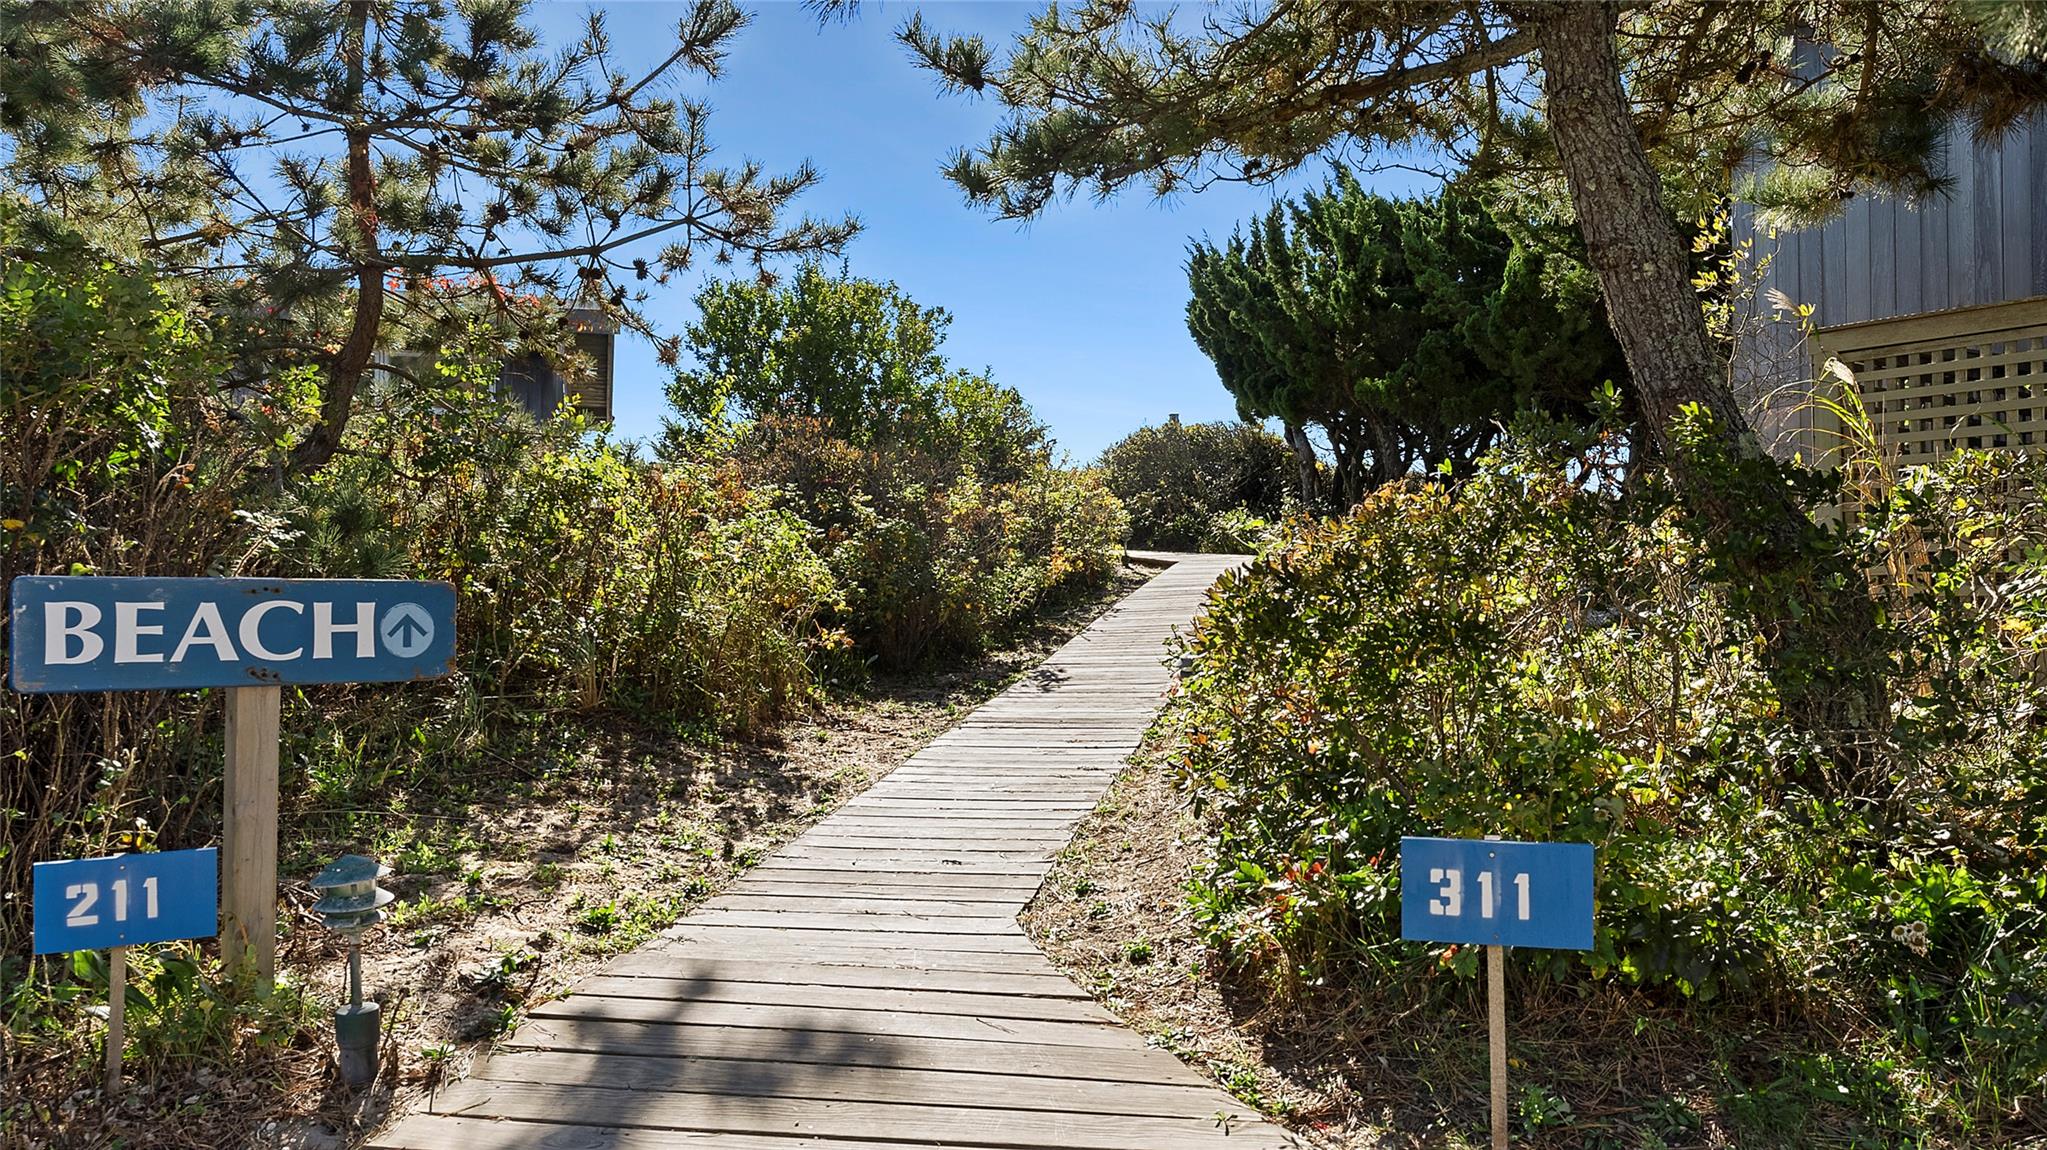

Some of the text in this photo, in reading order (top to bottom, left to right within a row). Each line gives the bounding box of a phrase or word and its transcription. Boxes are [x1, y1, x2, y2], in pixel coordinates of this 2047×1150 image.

[44, 601, 376, 665] BEACH
[66, 877, 158, 927] 211
[1429, 868, 1530, 920] 311
